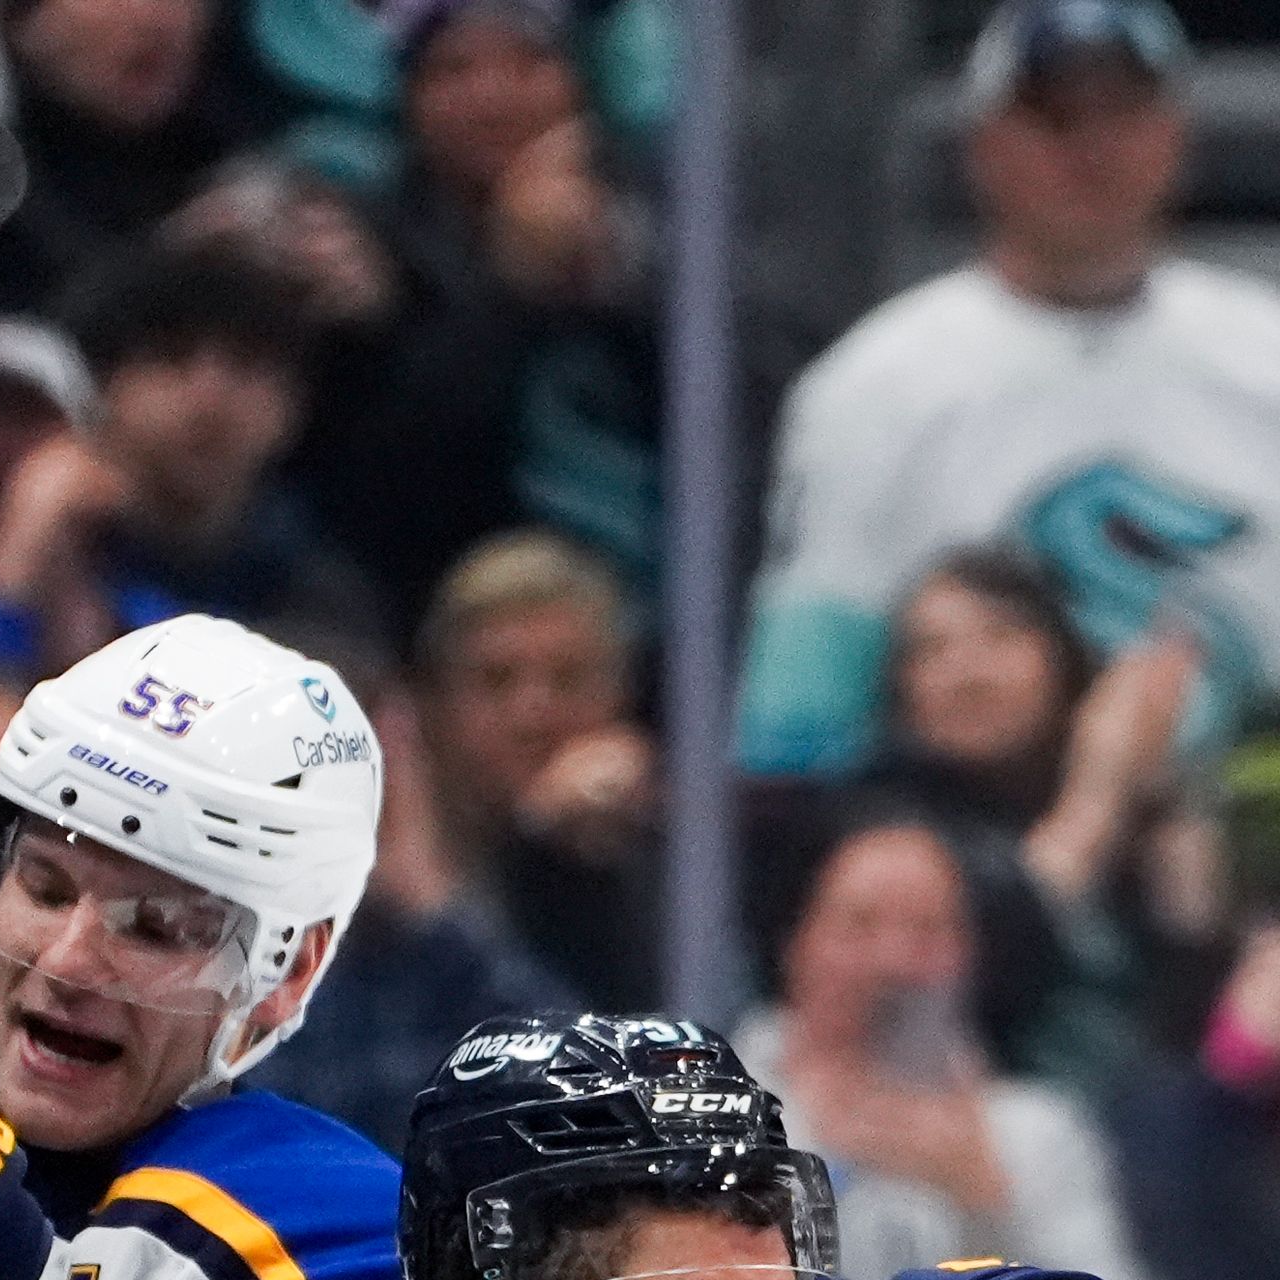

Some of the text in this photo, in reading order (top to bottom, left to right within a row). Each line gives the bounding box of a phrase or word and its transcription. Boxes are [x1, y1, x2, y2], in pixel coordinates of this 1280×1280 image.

[118, 673, 215, 739] 55
[68, 741, 169, 796] BAUER
[292, 730, 370, 769] CarShield
[448, 1031, 564, 1069] amazon
[651, 1093, 752, 1115] CCM
